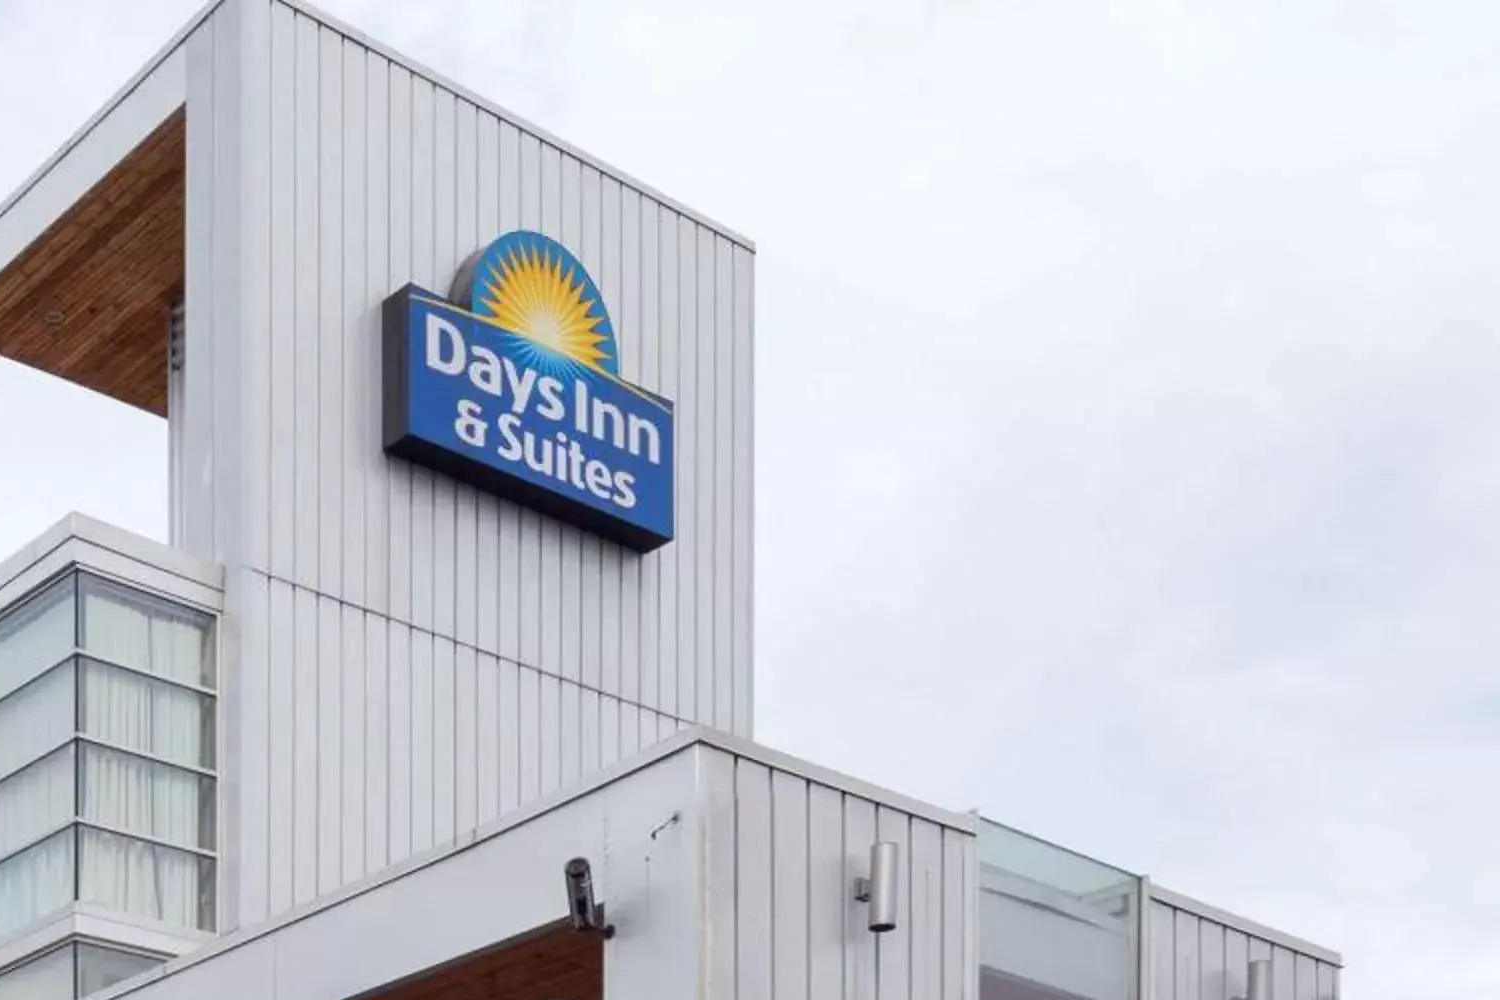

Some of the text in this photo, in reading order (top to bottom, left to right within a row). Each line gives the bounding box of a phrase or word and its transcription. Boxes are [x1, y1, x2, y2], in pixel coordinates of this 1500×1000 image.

[426, 312, 660, 465] Days Inn
[454, 399, 637, 508] & Suites
